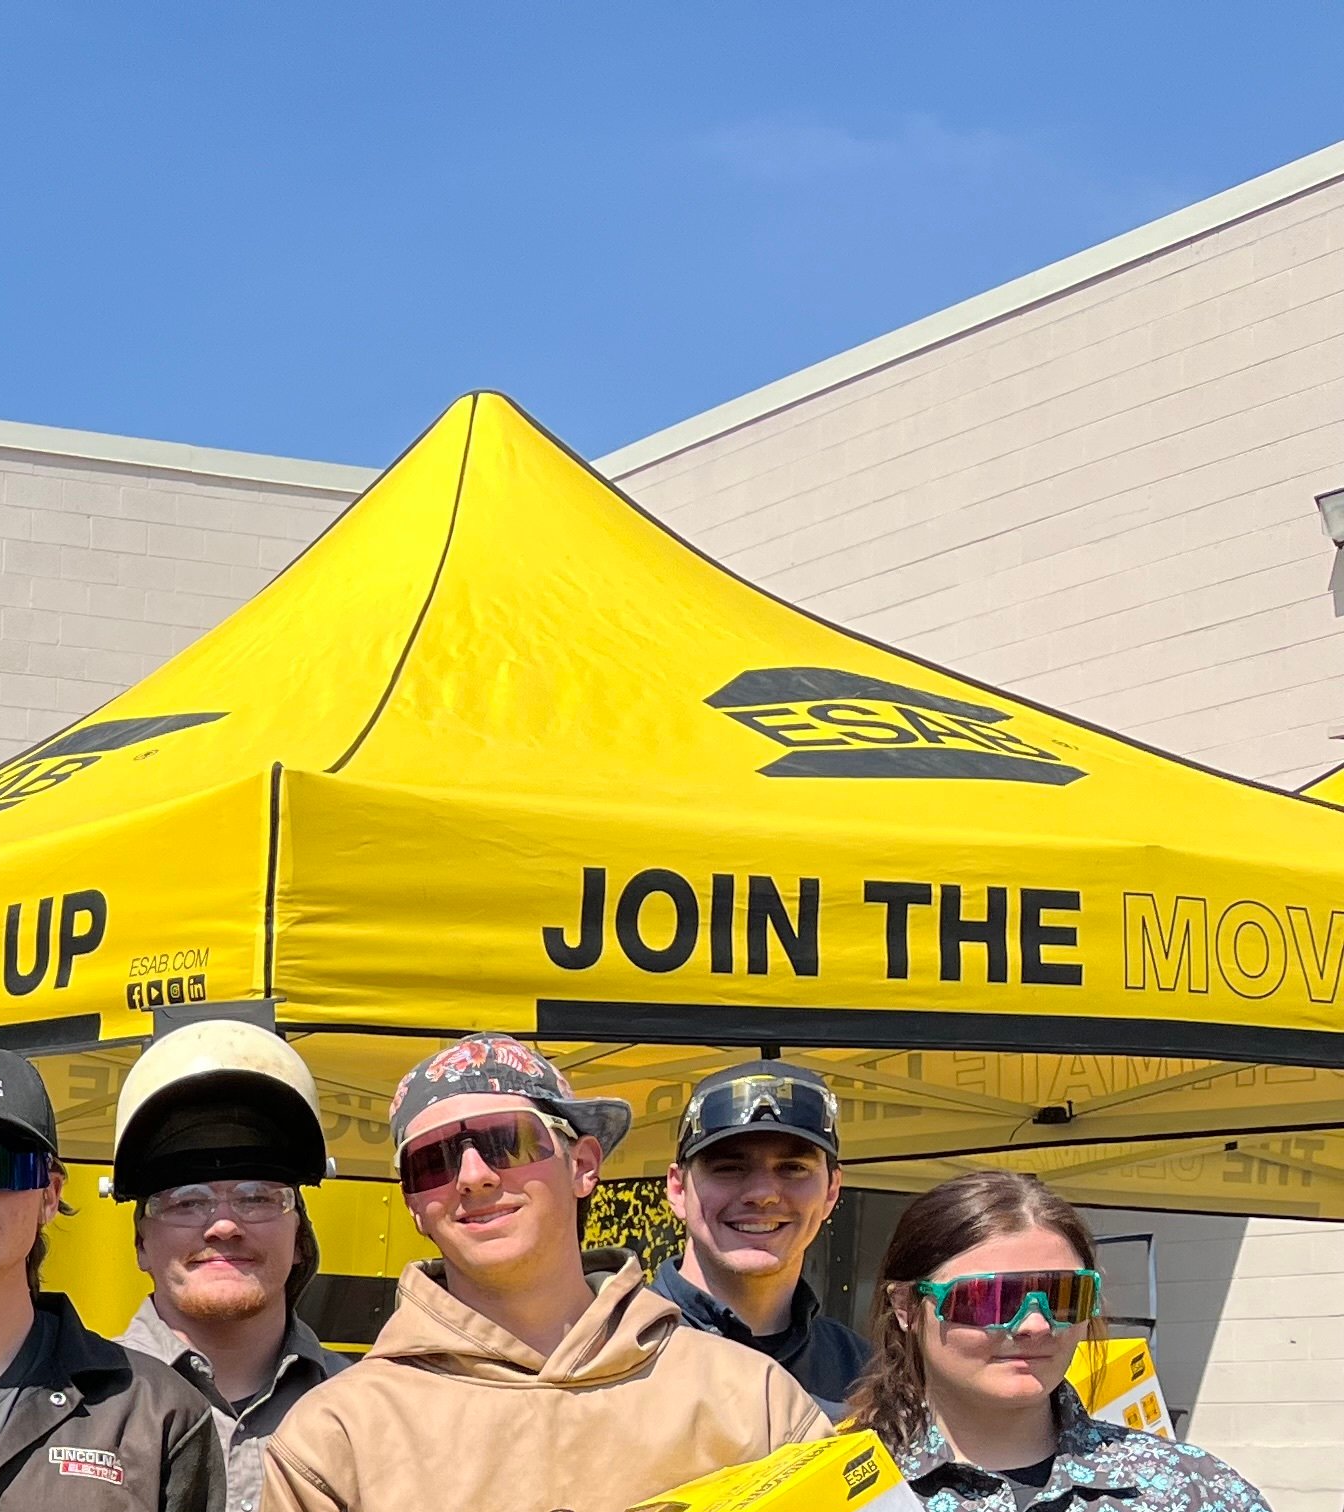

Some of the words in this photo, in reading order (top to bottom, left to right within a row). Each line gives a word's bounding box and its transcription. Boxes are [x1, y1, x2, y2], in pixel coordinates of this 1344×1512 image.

[721, 703, 1062, 762] ESAB
[541, 866, 819, 976] JOIN
[863, 879, 1083, 986] THE
[1123, 891, 1344, 1004] MOV
[128, 946, 210, 978] ESAB.COM
[52, 1448, 115, 1466] LINCOLN
[67, 1463, 120, 1482] ELECTRIC
[845, 1459, 878, 1488] ESAB
